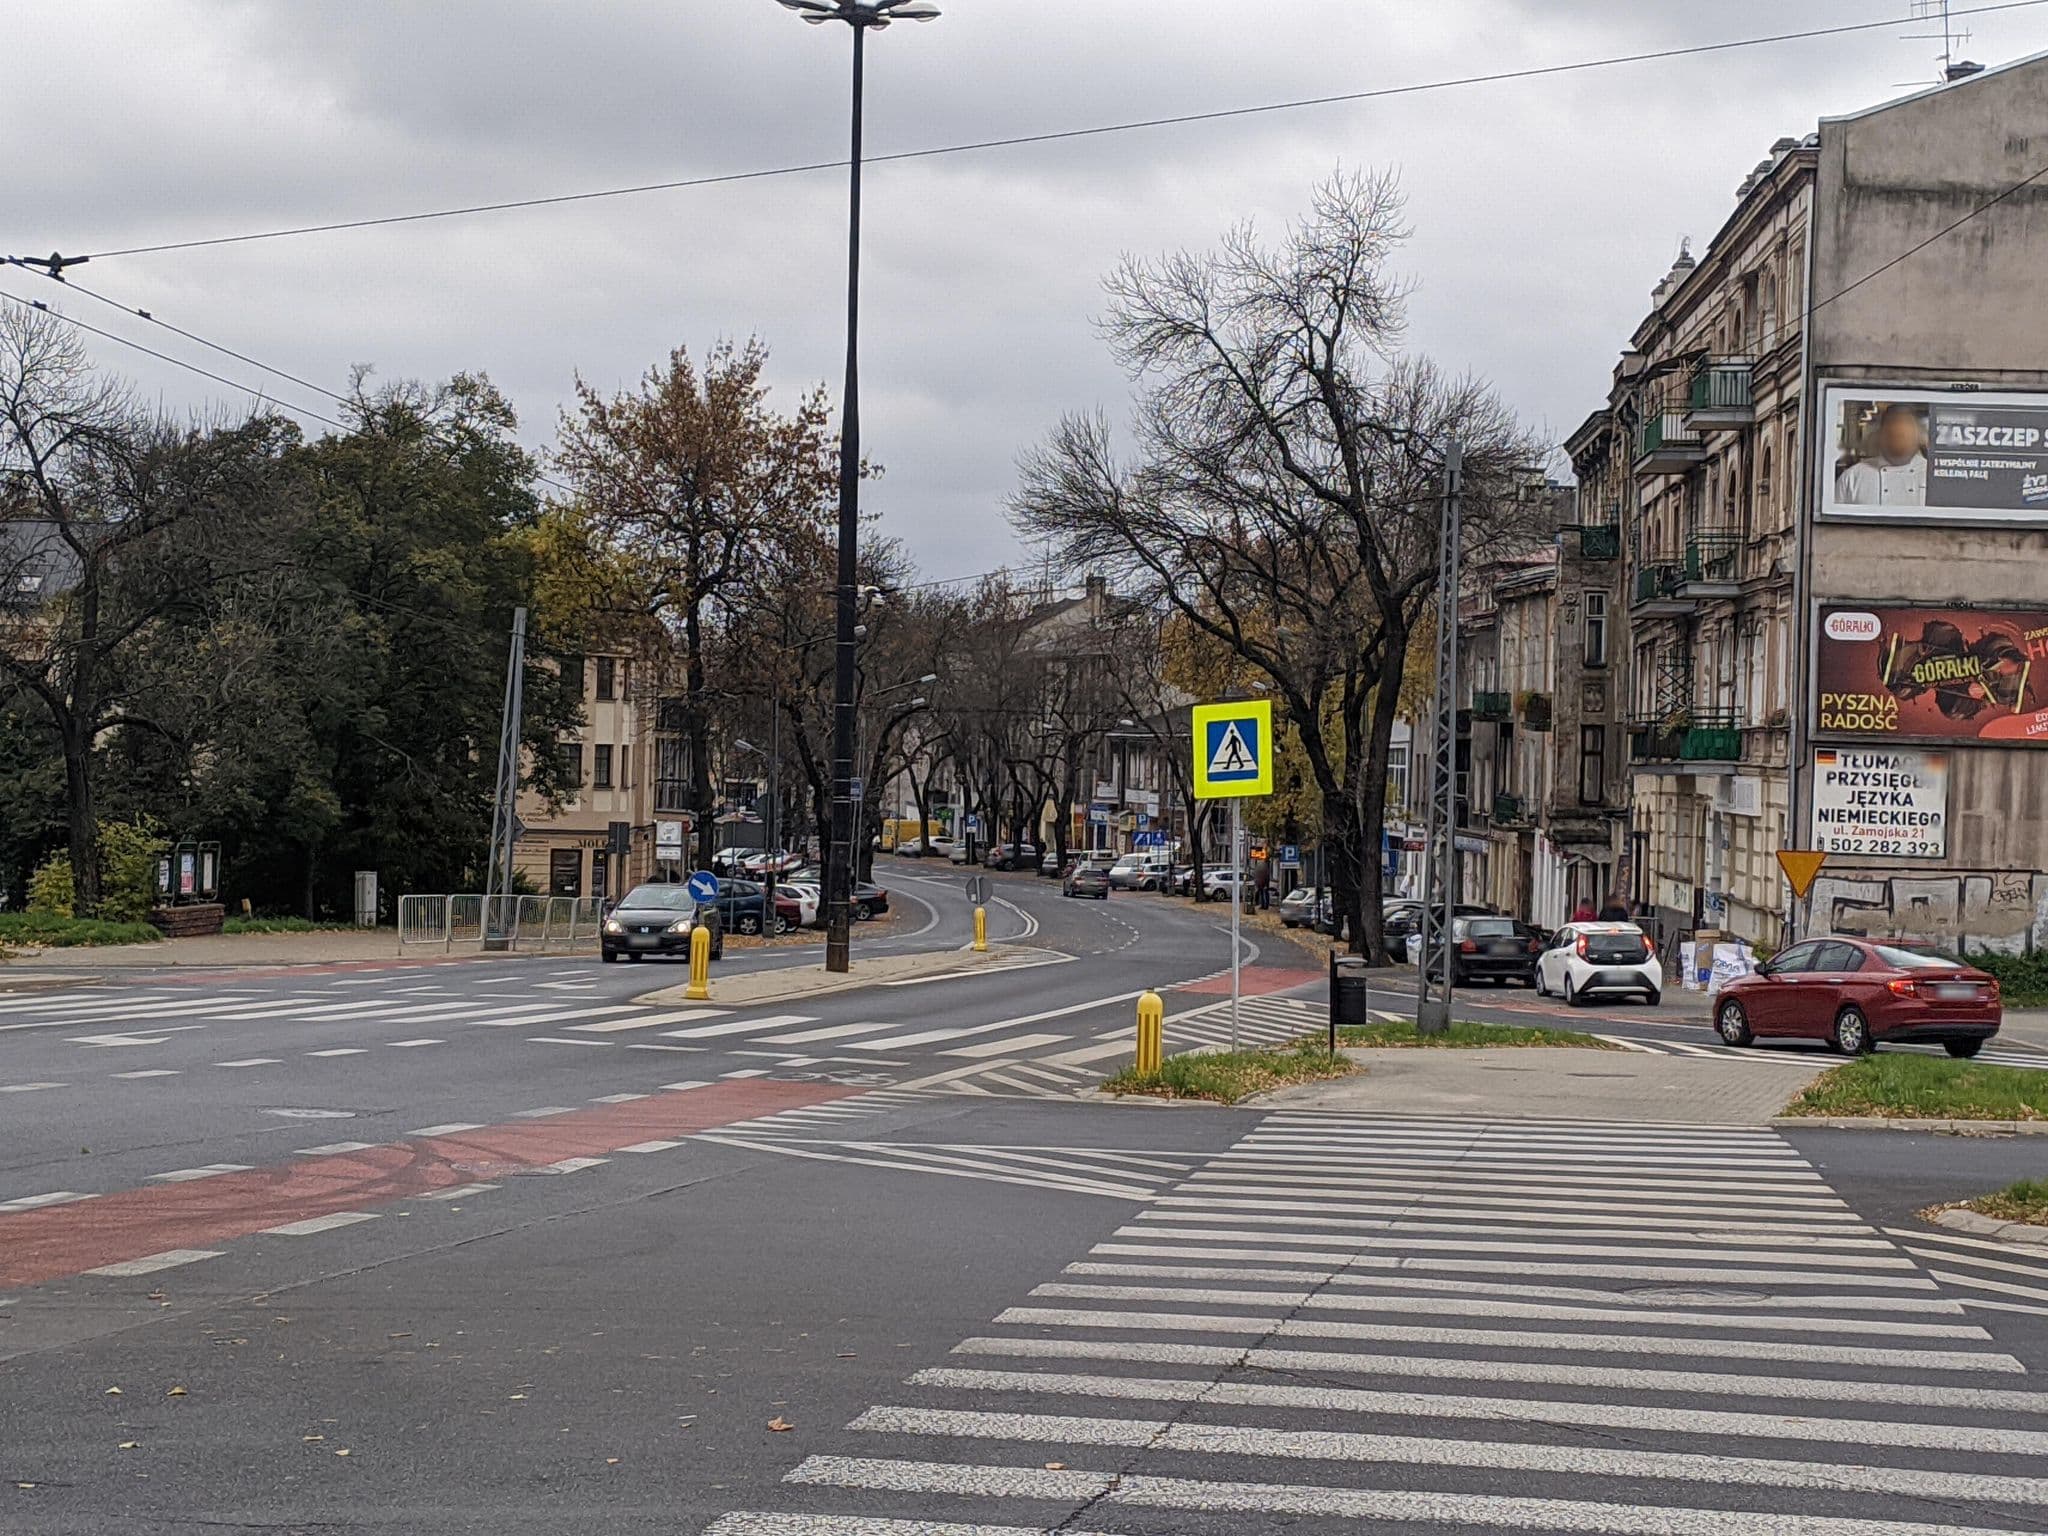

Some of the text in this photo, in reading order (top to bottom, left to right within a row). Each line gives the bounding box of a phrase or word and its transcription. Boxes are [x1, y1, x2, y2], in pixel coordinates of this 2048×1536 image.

[1936, 425, 2040, 447] ZASZCZEP
[1821, 693, 1899, 712] PYSZNĄ
[1820, 711, 1899, 731] RADOŚĆ
[1826, 771, 1930, 792] PRZYSIĘGŁ
[1846, 790, 1914, 809] JĘZYKA
[1817, 807, 1942, 828] NIEMIECKIEGO
[1833, 825, 1925, 839] ul. Zamojska 21
[1831, 838, 1941, 855] 502 282 393
